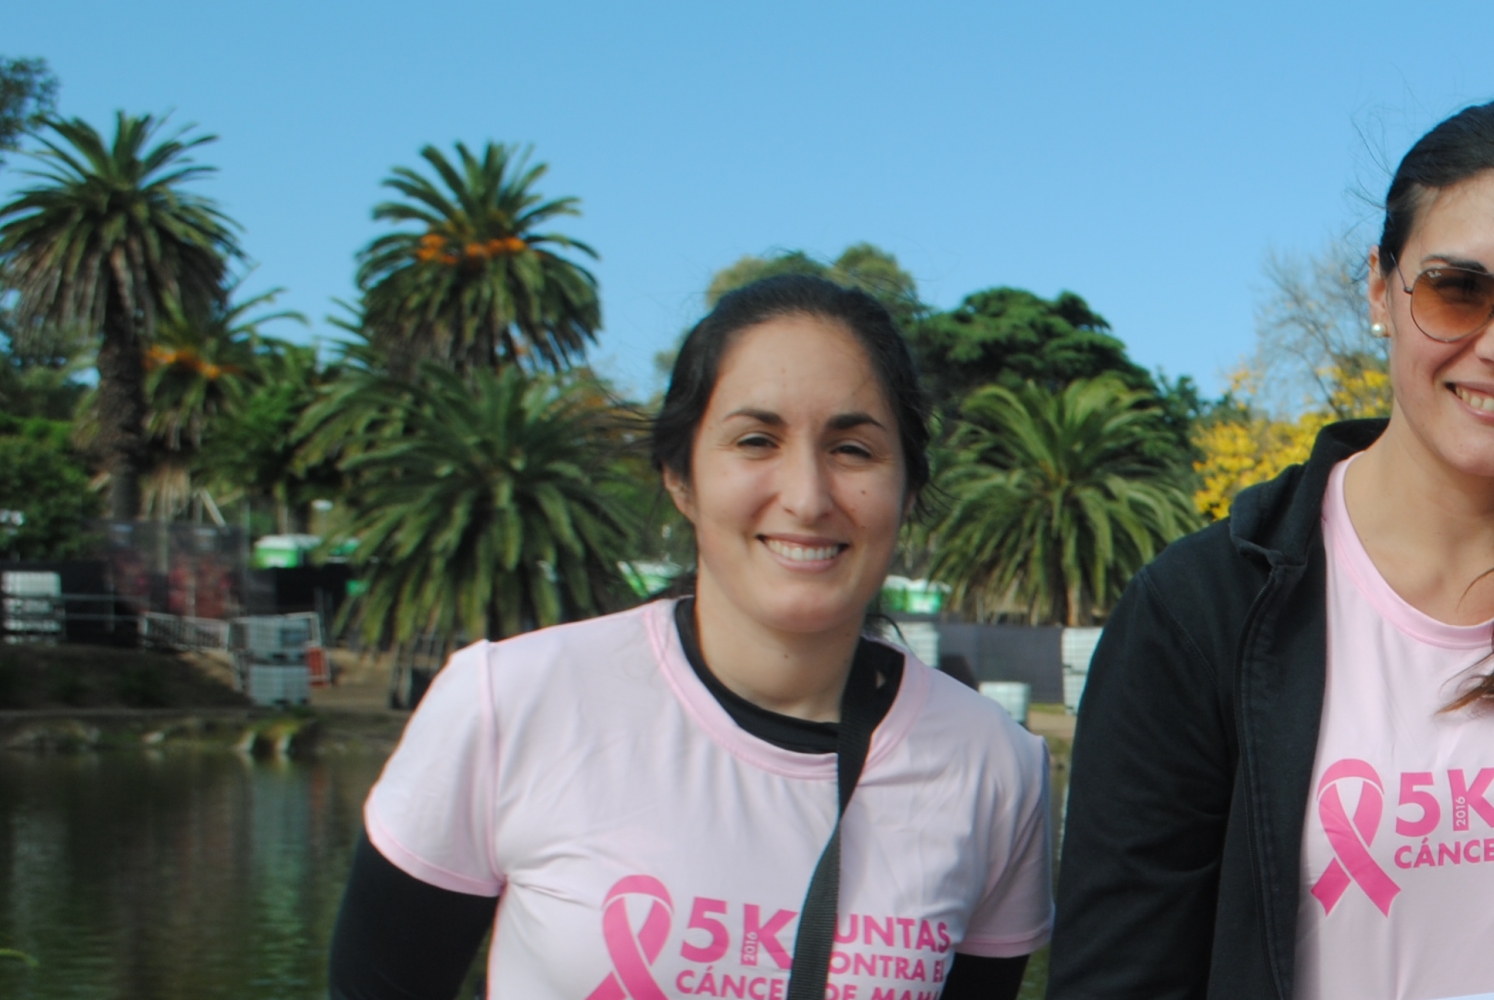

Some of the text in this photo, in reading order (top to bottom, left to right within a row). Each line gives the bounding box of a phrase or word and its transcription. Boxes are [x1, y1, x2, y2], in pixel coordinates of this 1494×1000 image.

[1455, 795, 1467, 827] 2016
[680, 896, 798, 971] 5K
[742, 931, 758, 962] 2016
[832, 913, 951, 953] UNTAS
[826, 949, 927, 982] ONTRA
